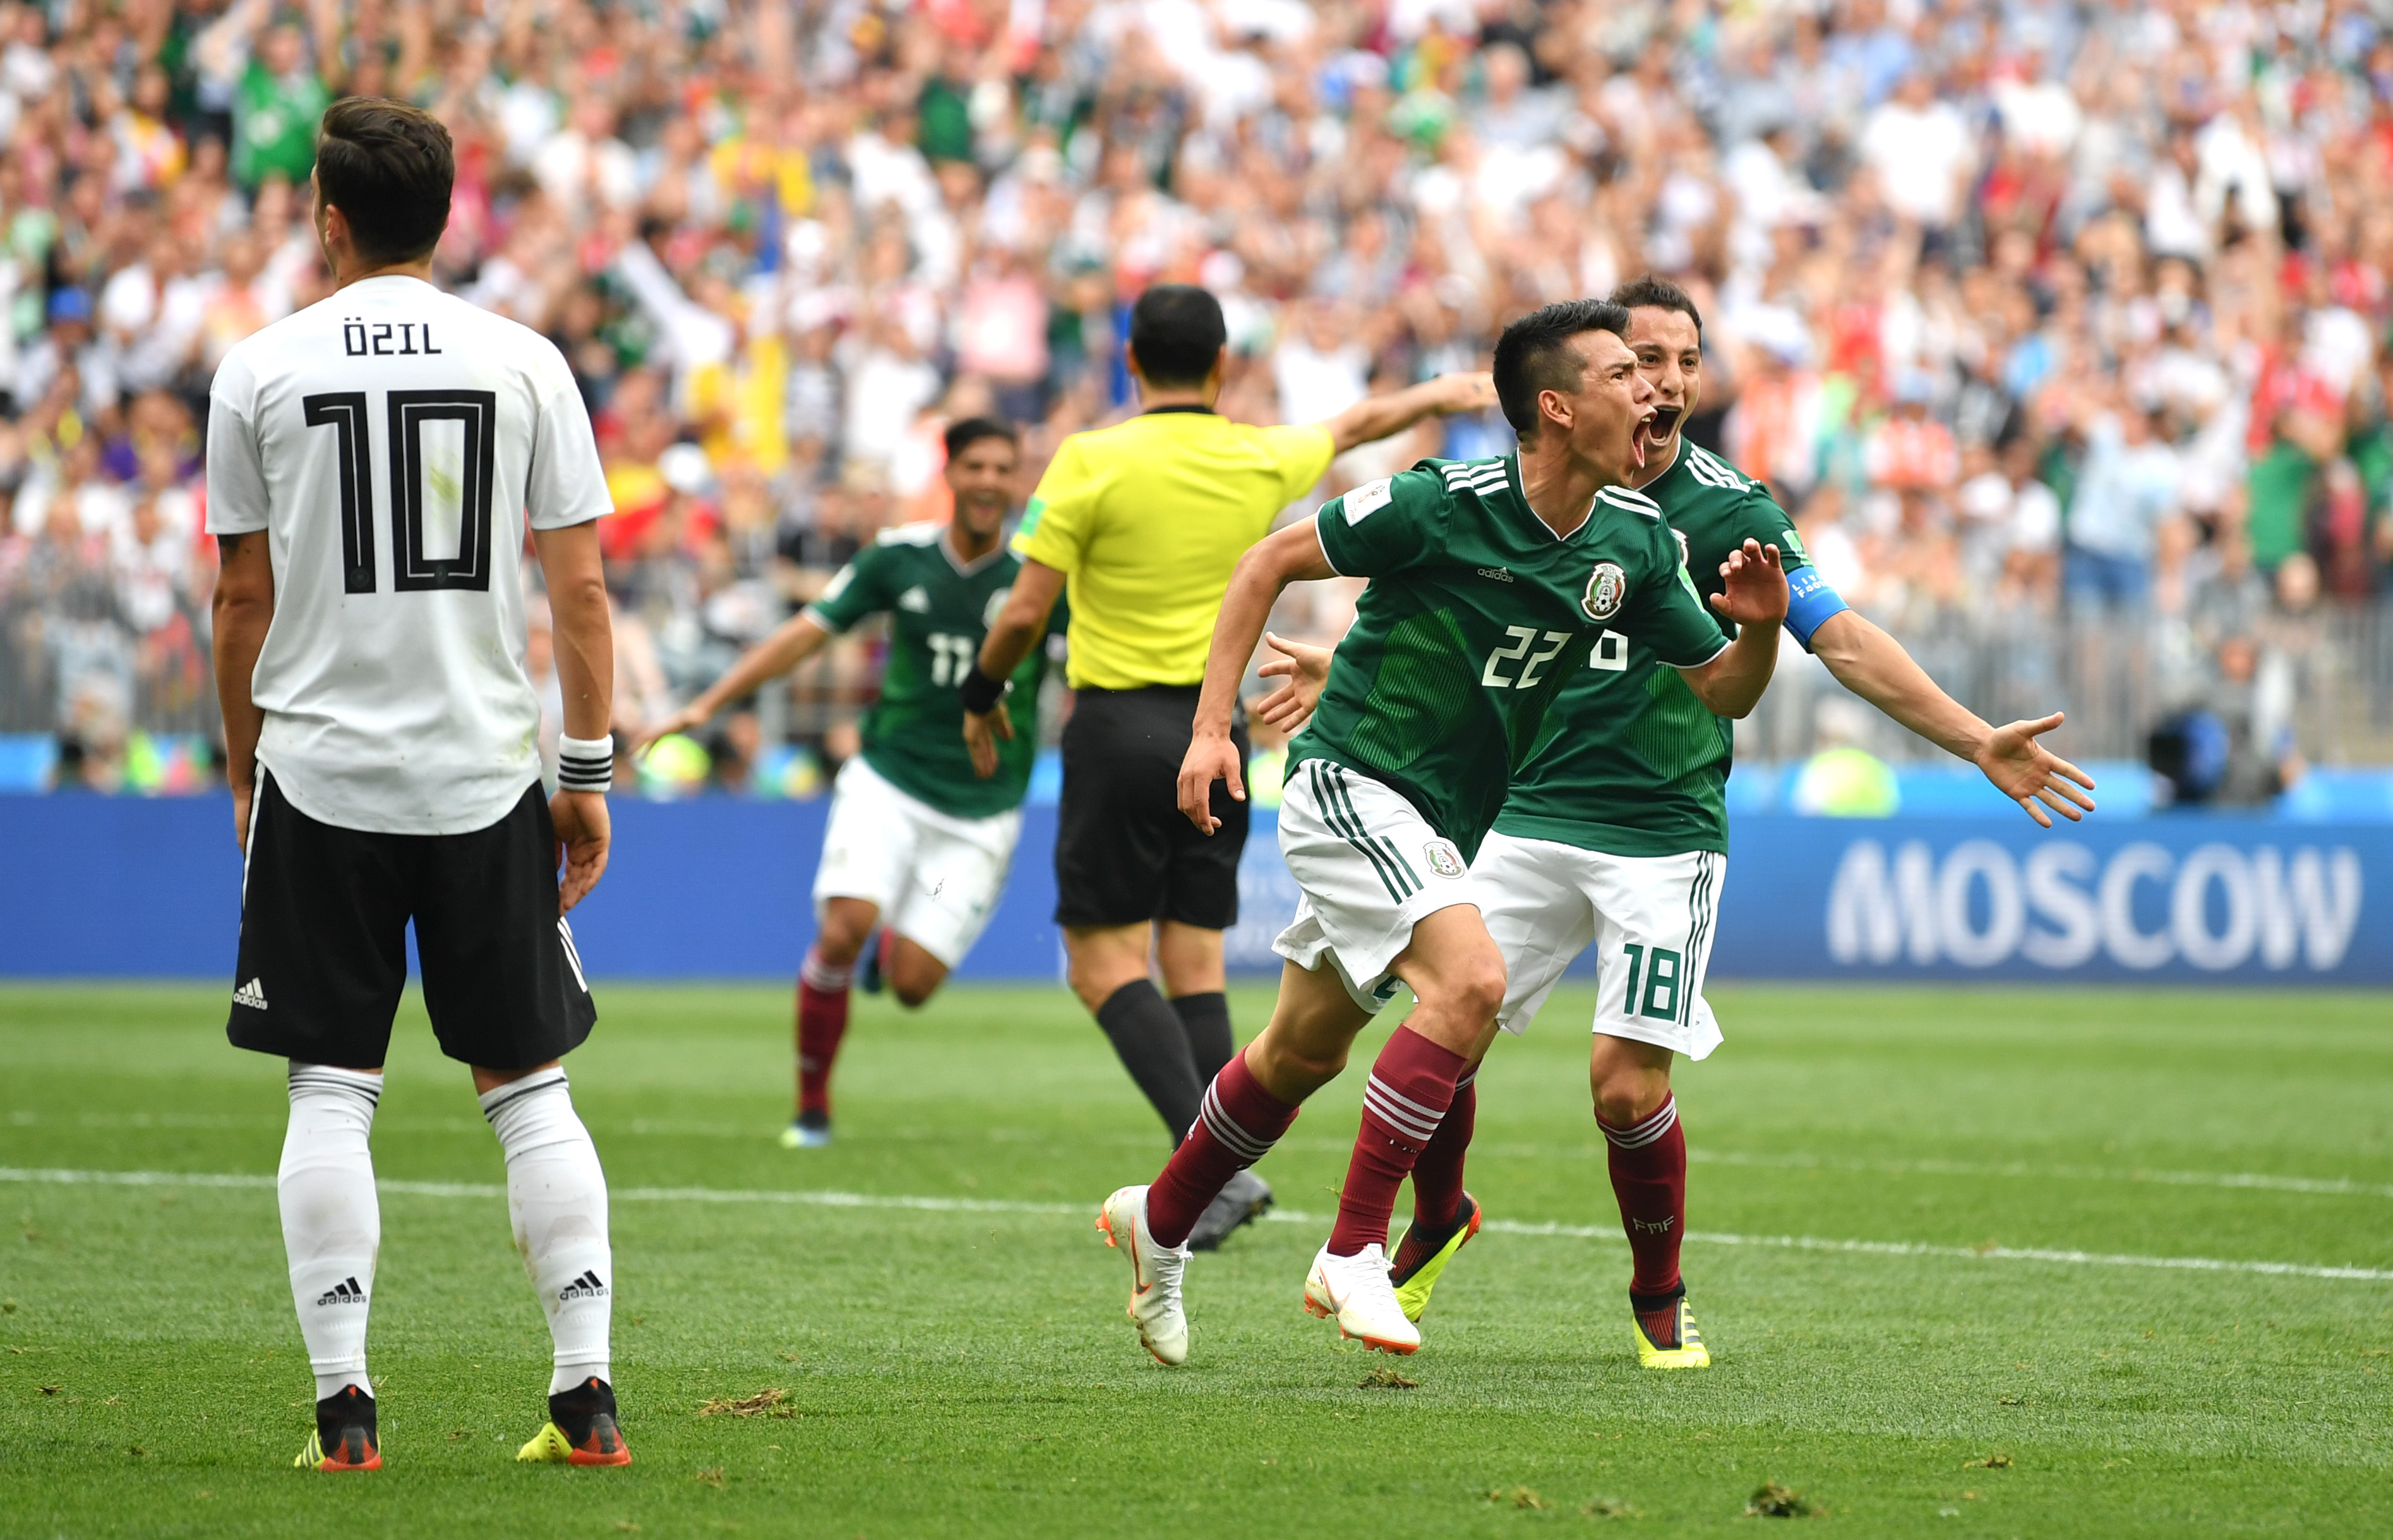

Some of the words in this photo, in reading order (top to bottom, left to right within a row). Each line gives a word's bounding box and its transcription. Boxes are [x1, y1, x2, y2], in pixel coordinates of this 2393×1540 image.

[344, 317, 441, 356] ÖZIL
[303, 391, 496, 594] 10
[1477, 568, 1514, 583] adidas
[1482, 624, 1573, 689] 22
[1825, 839, 2363, 971] MOSCOW
[233, 992, 268, 1010] adidas
[1624, 943, 1681, 1022] 18
[317, 1294, 367, 1306] adidas
[559, 1287, 609, 1301] adidas
